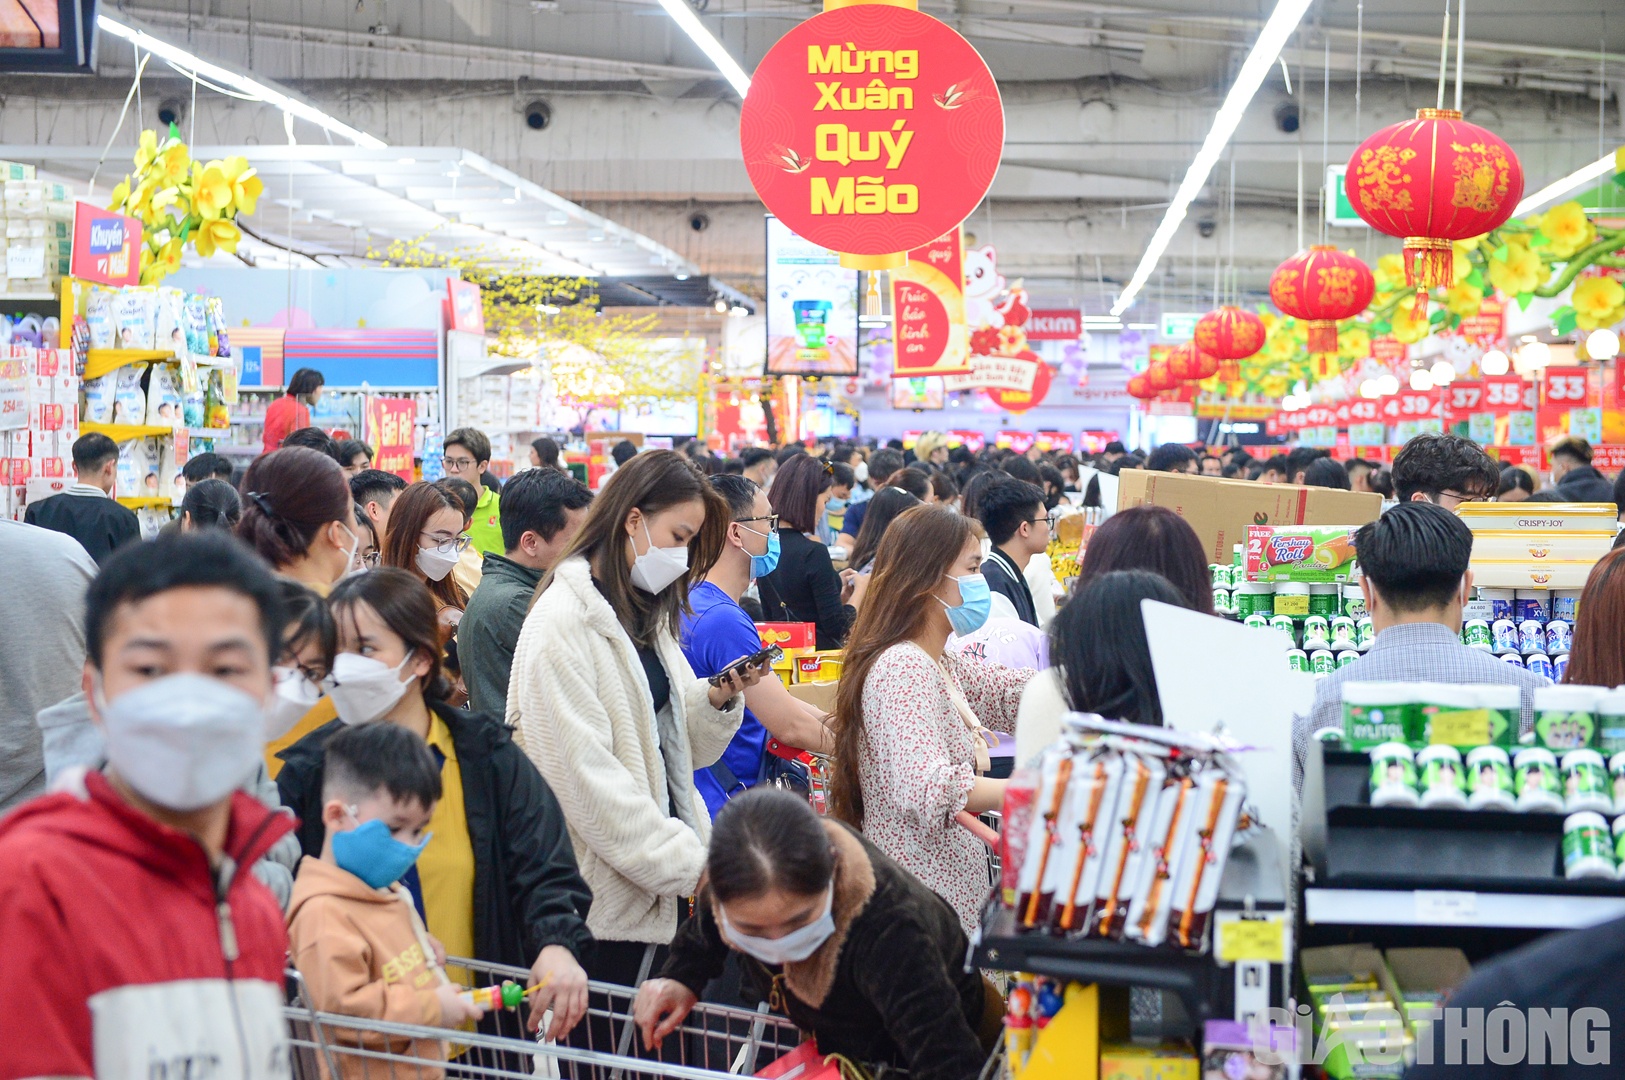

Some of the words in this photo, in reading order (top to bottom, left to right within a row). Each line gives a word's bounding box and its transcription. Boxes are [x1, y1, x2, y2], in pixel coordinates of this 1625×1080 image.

[807, 42, 919, 79] Mừng
[813, 79, 914, 112] Xuân
[815, 119, 914, 169] Quý
[810, 175, 919, 215] Mão
[91, 221, 123, 251] Khuyến
[928, 246, 953, 263] quý
[900, 287, 929, 304] Trúc
[900, 323, 930, 341] bình
[906, 343, 925, 358] an
[1487, 383, 1520, 404] 35
[1548, 375, 1586, 400] 33
[1401, 395, 1430, 415] 39
[1451, 387, 1482, 408] 37
[1351, 402, 1376, 419] 43
[382, 411, 398, 447] Giá
[1518, 519, 1564, 527] CRISPY-JOY
[1249, 530, 1271, 538] FREE
[1271, 536, 1310, 548] Fershay
[1249, 539, 1262, 553] 2
[1276, 548, 1304, 561] Roll
[1292, 560, 1328, 570] Pandan
[801, 663, 819, 671] COSY
